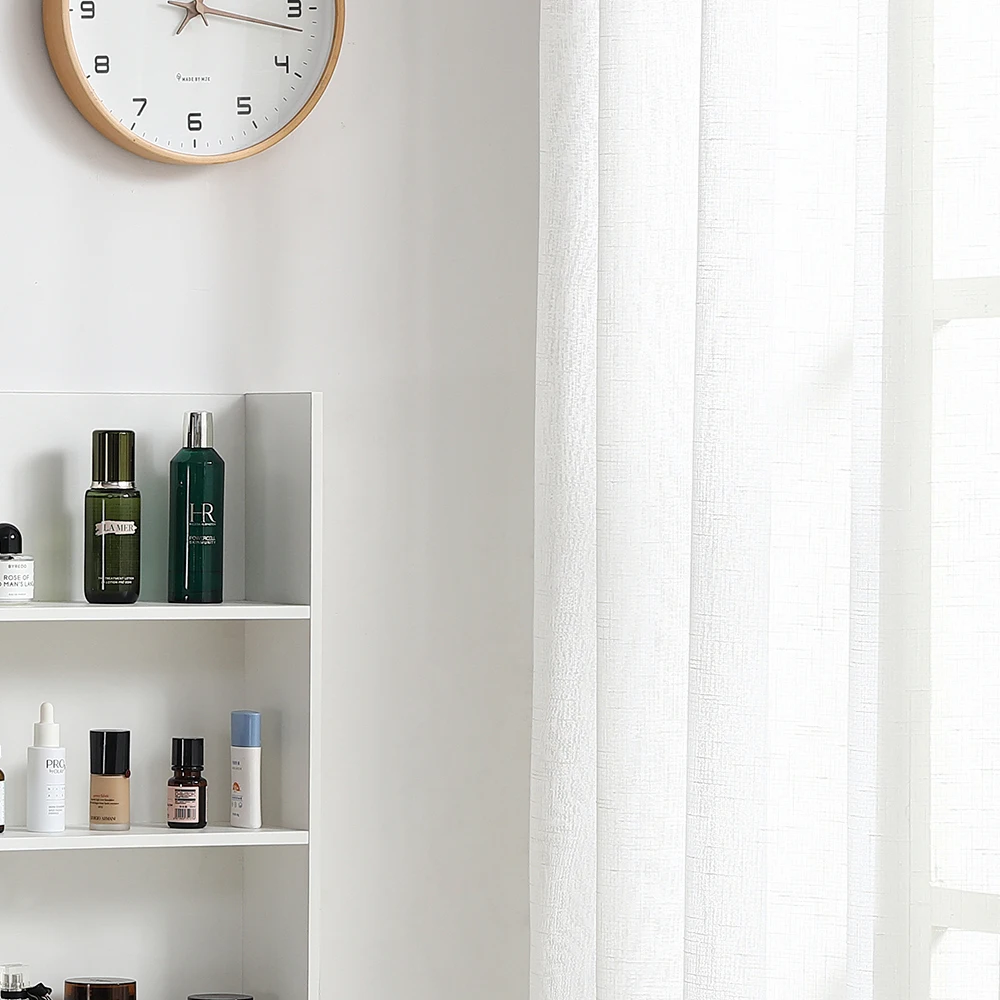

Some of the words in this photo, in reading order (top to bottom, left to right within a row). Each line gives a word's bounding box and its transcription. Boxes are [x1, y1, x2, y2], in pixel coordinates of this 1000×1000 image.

[80, 0, 95, 19] 9
[287, 0, 302, 18] 3
[94, 55, 110, 74] 8
[274, 55, 290, 74] 4
[132, 97, 148, 117] 7
[236, 96, 252, 115] 5
[187, 112, 203, 132] 6
[190, 502, 217, 523] HR
[104, 524, 115, 532] LA
[116, 524, 134, 532] MER
